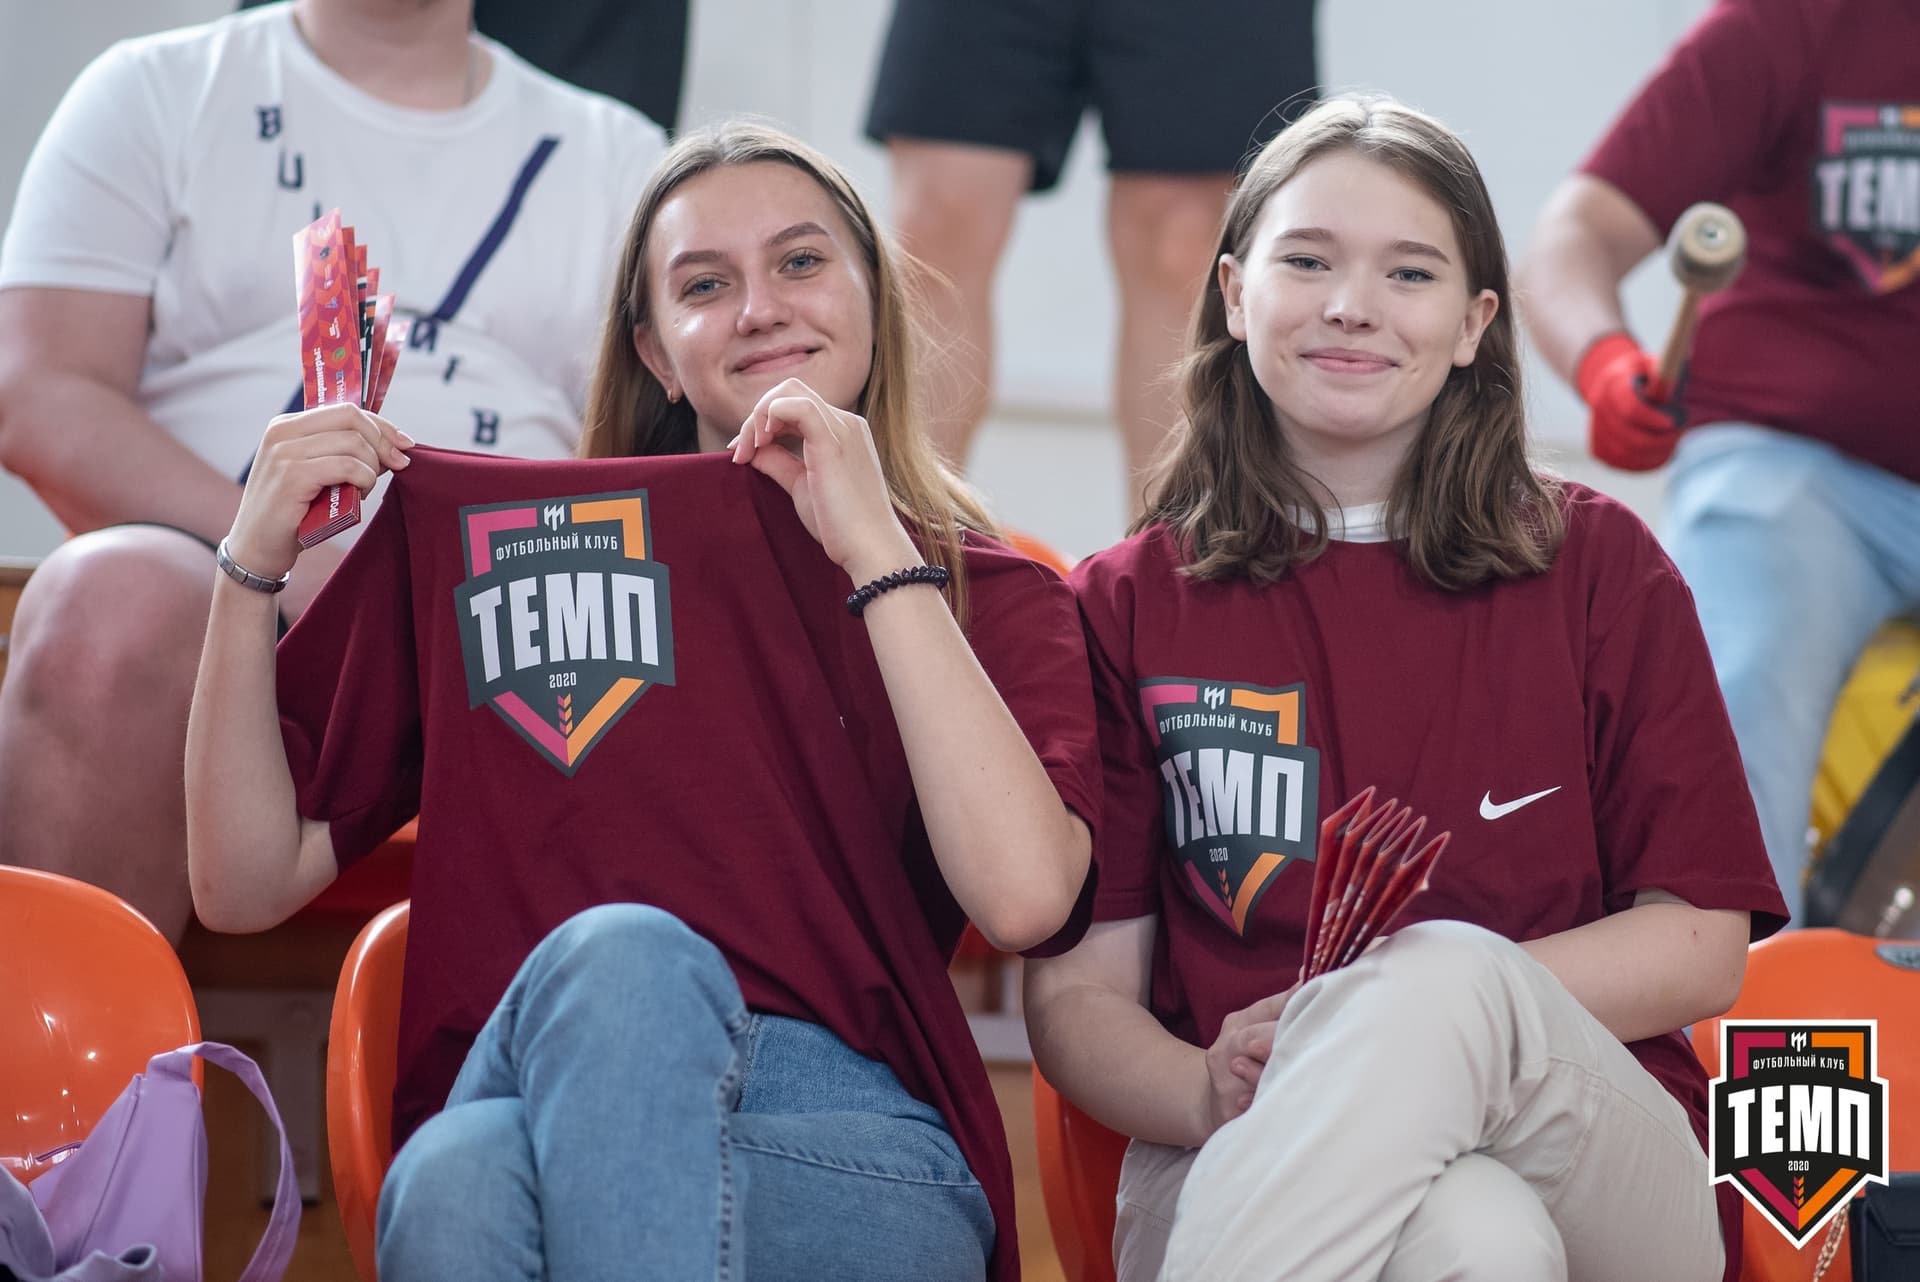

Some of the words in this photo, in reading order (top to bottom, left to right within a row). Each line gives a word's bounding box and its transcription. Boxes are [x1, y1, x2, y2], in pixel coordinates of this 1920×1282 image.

[496, 532, 579, 561] ФУТБОЛЬНЫЙ
[585, 535, 618, 551] КЛУБ
[469, 572, 659, 683] ТЕМП
[549, 672, 577, 688] 2020
[1159, 713, 1236, 735] ФУТБОЛЬНЫЙ
[1240, 719, 1273, 737] КЛУБ
[1160, 748, 1305, 849] ТЕМП
[1209, 847, 1229, 863] 2020
